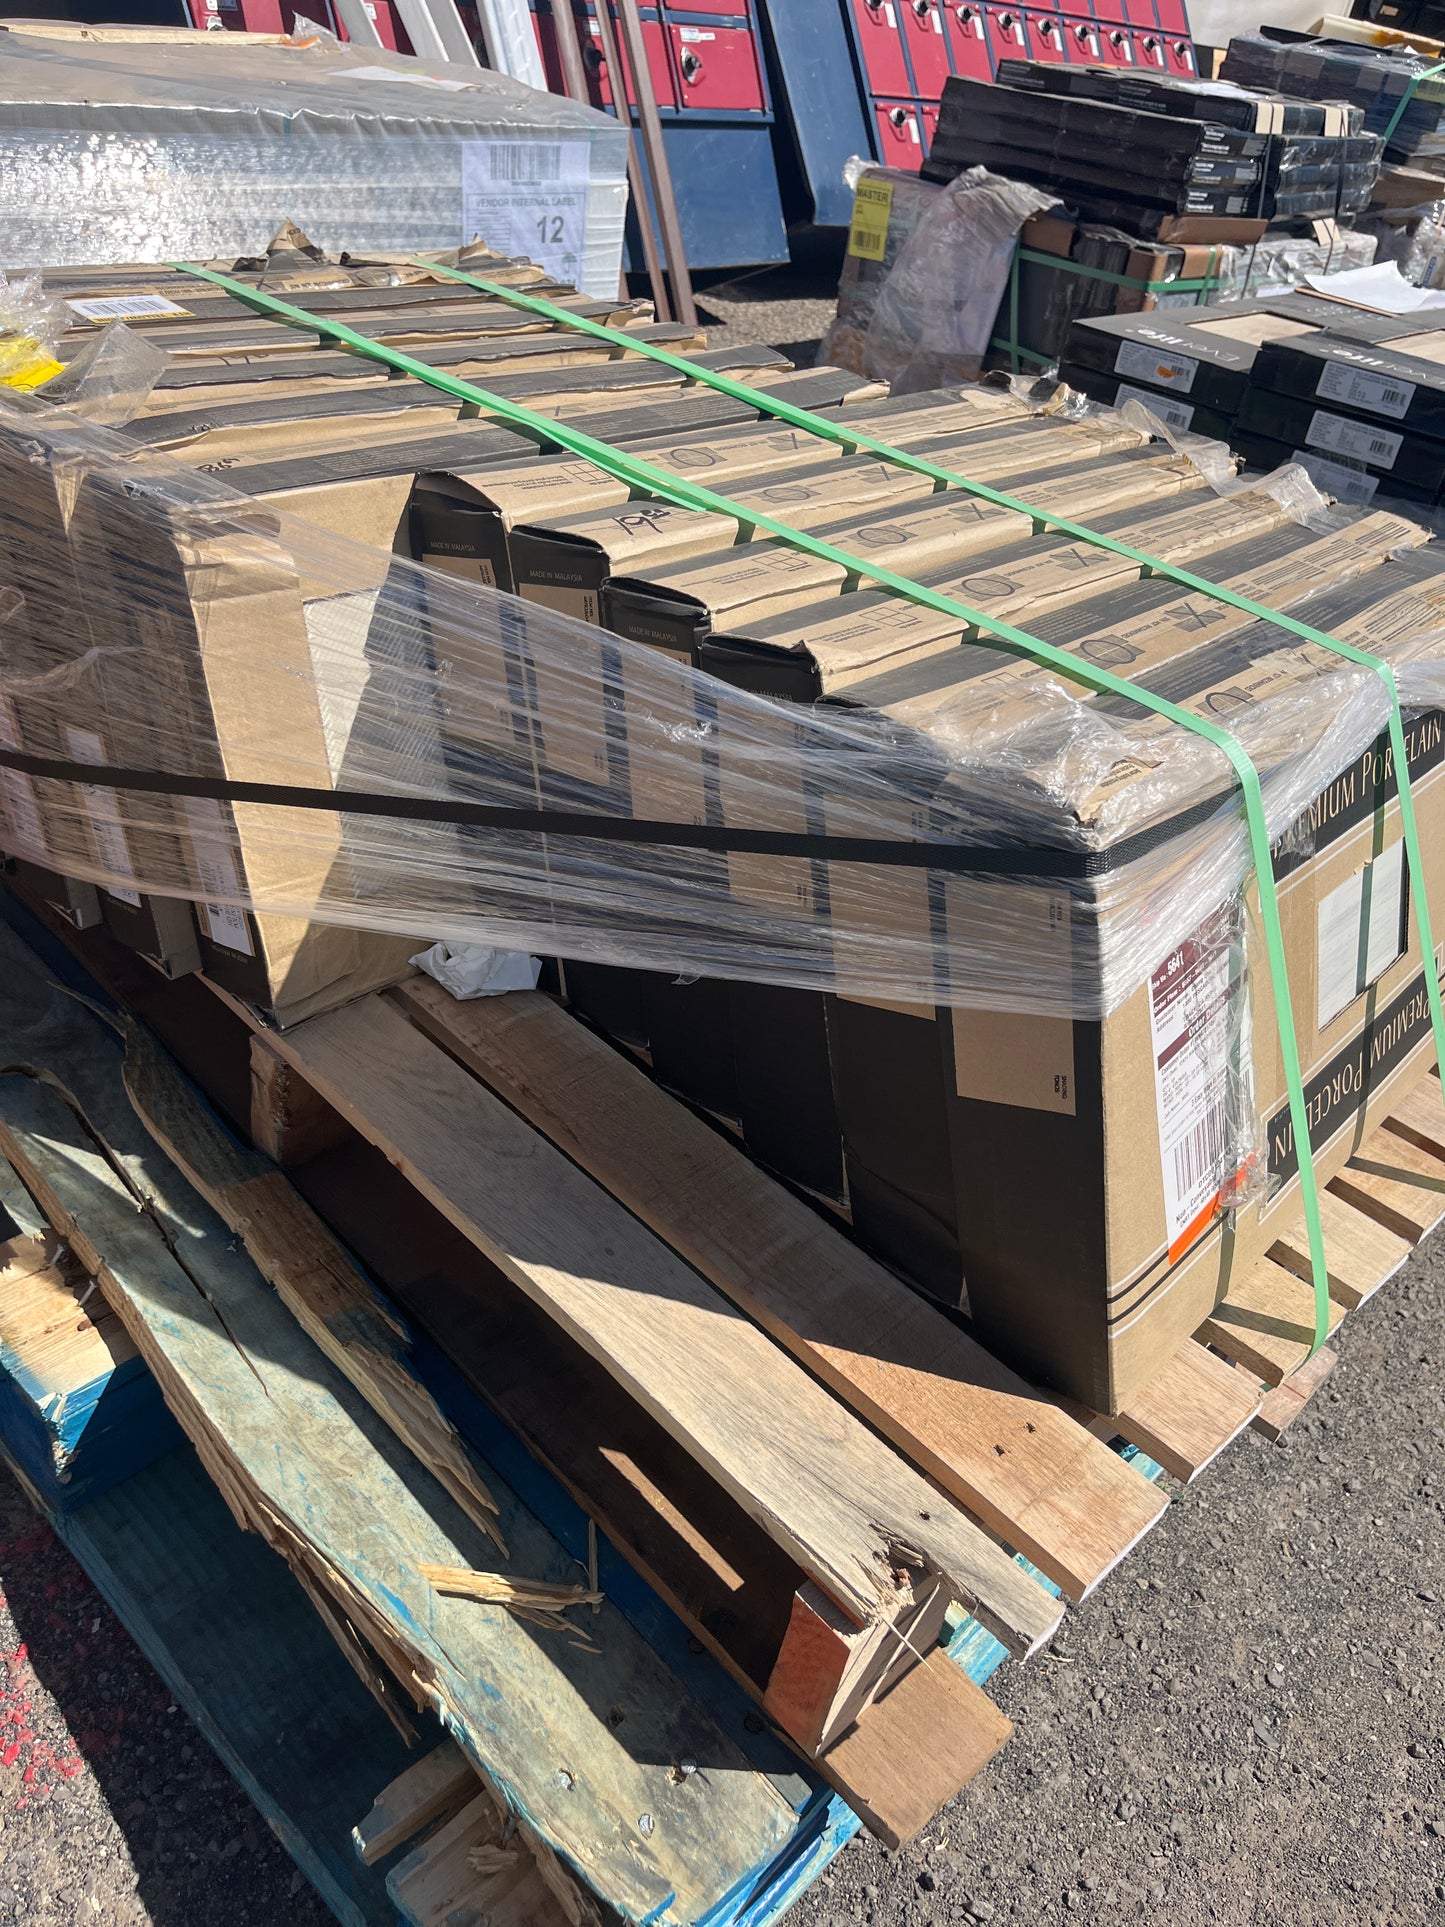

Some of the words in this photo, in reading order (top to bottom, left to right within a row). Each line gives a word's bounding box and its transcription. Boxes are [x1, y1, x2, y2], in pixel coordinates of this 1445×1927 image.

[475, 198, 509, 208] VENDOR
[512, 198, 549, 207] INTERNAL
[552, 197, 577, 207] LABEL
[537, 216, 564, 243] 12
[529, 569, 547, 578] MADE
[554, 571, 583, 582] MALAYSIA
[628, 625, 643, 635] MADE
[651, 630, 677, 642] MALAYSIA
[1362, 714, 1441, 797] PORELAIN
[1188, 1014, 1206, 1038] Order
[1370, 990, 1430, 1068] PREMIUM
[1275, 1051, 1363, 1166] PORCELIN
